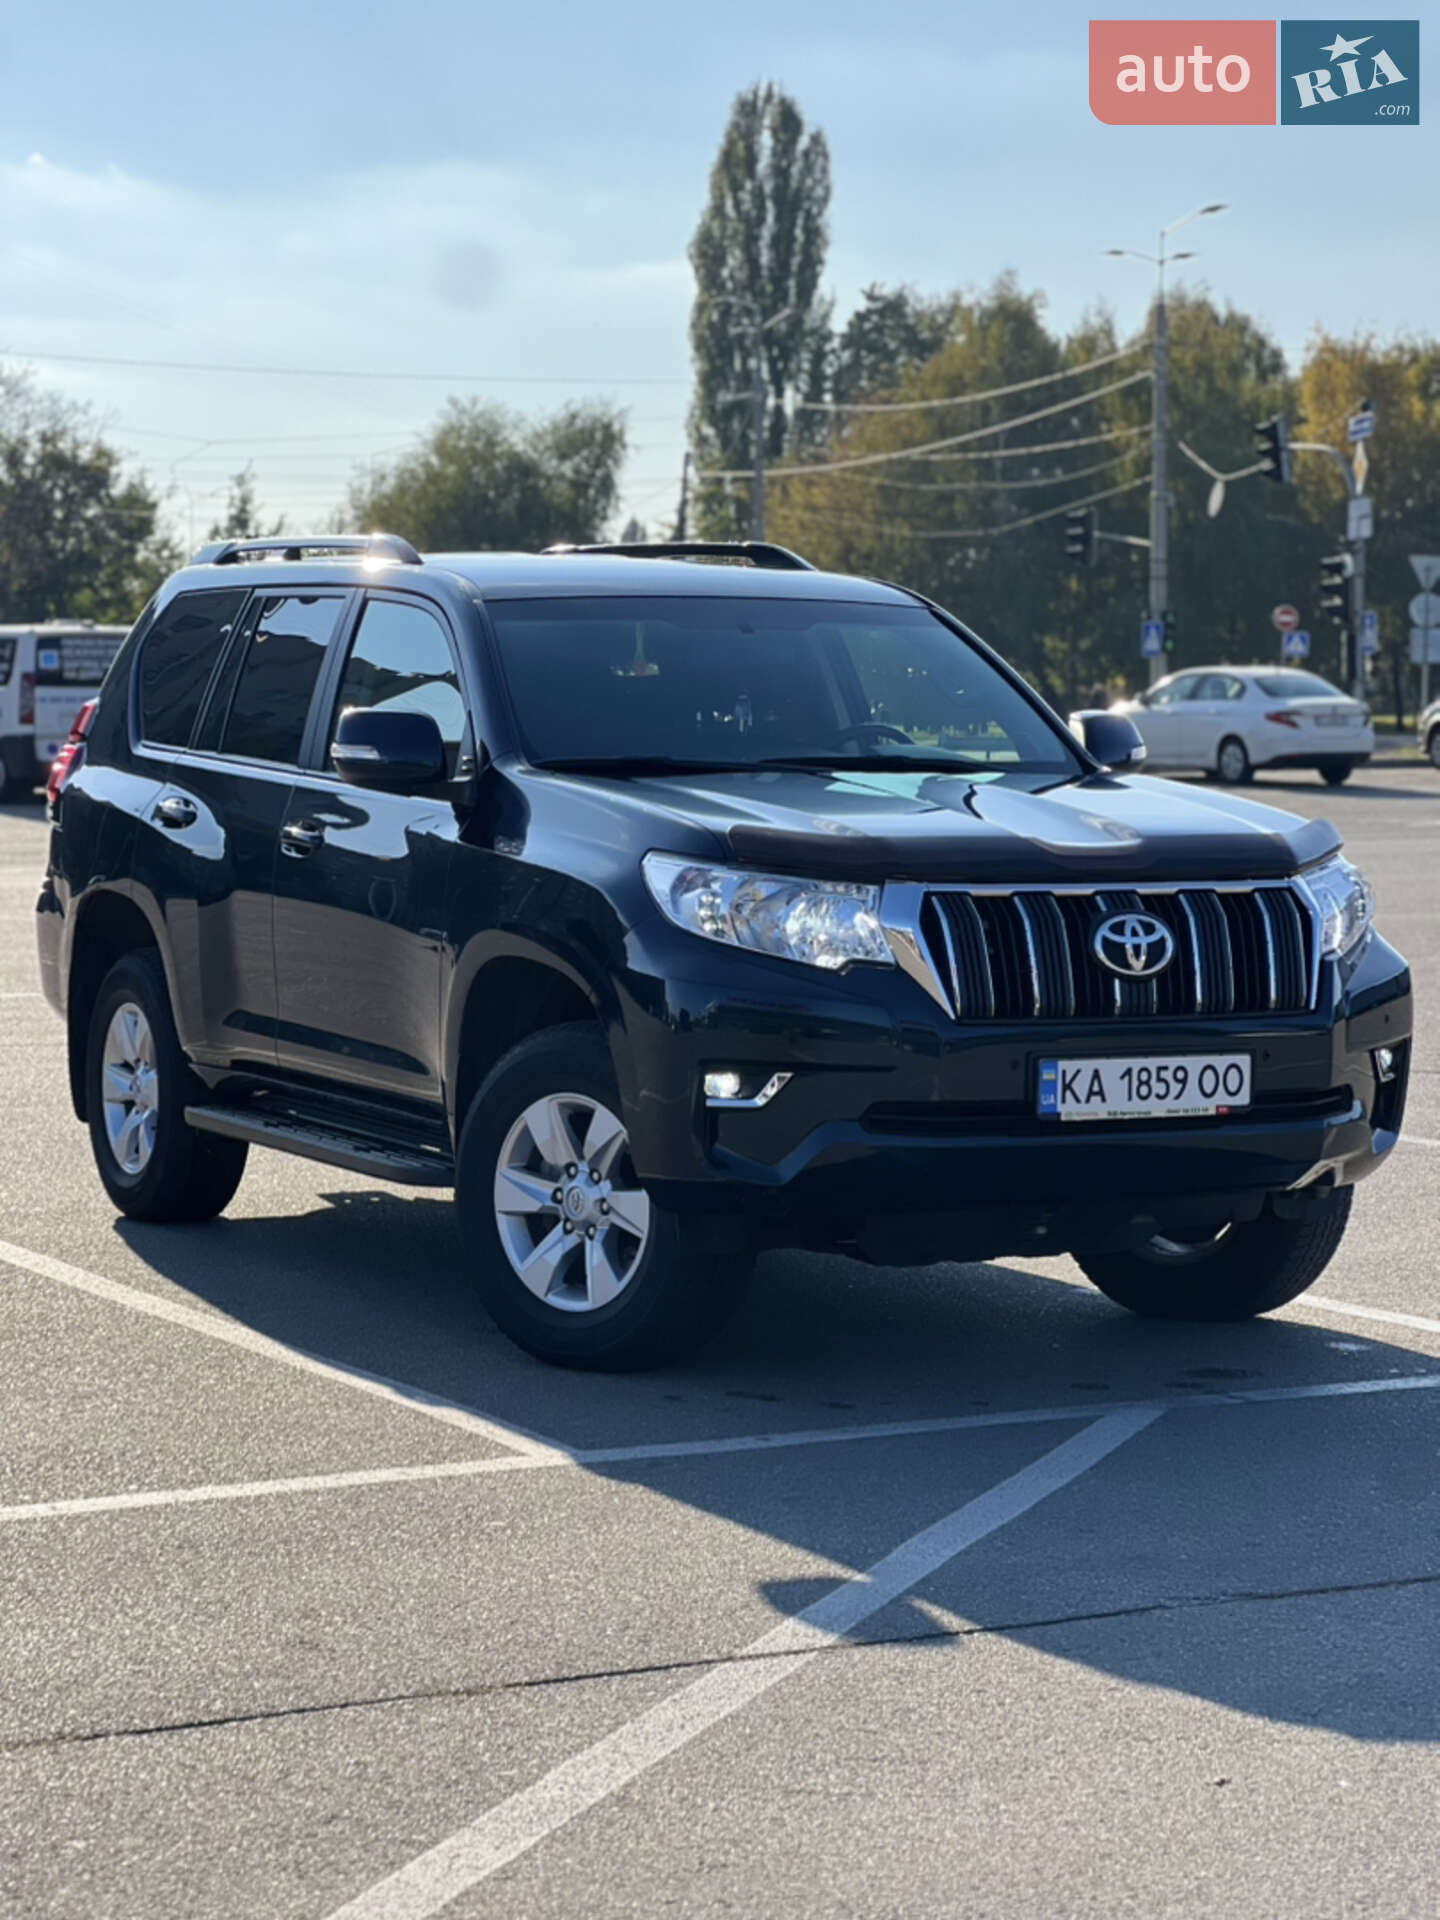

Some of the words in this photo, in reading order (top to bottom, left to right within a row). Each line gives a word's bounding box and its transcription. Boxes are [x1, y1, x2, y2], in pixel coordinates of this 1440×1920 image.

[1060, 1067, 1107, 1105] KA
[1119, 1064, 1189, 1102] 1859
[1197, 1062, 1245, 1099] OO
